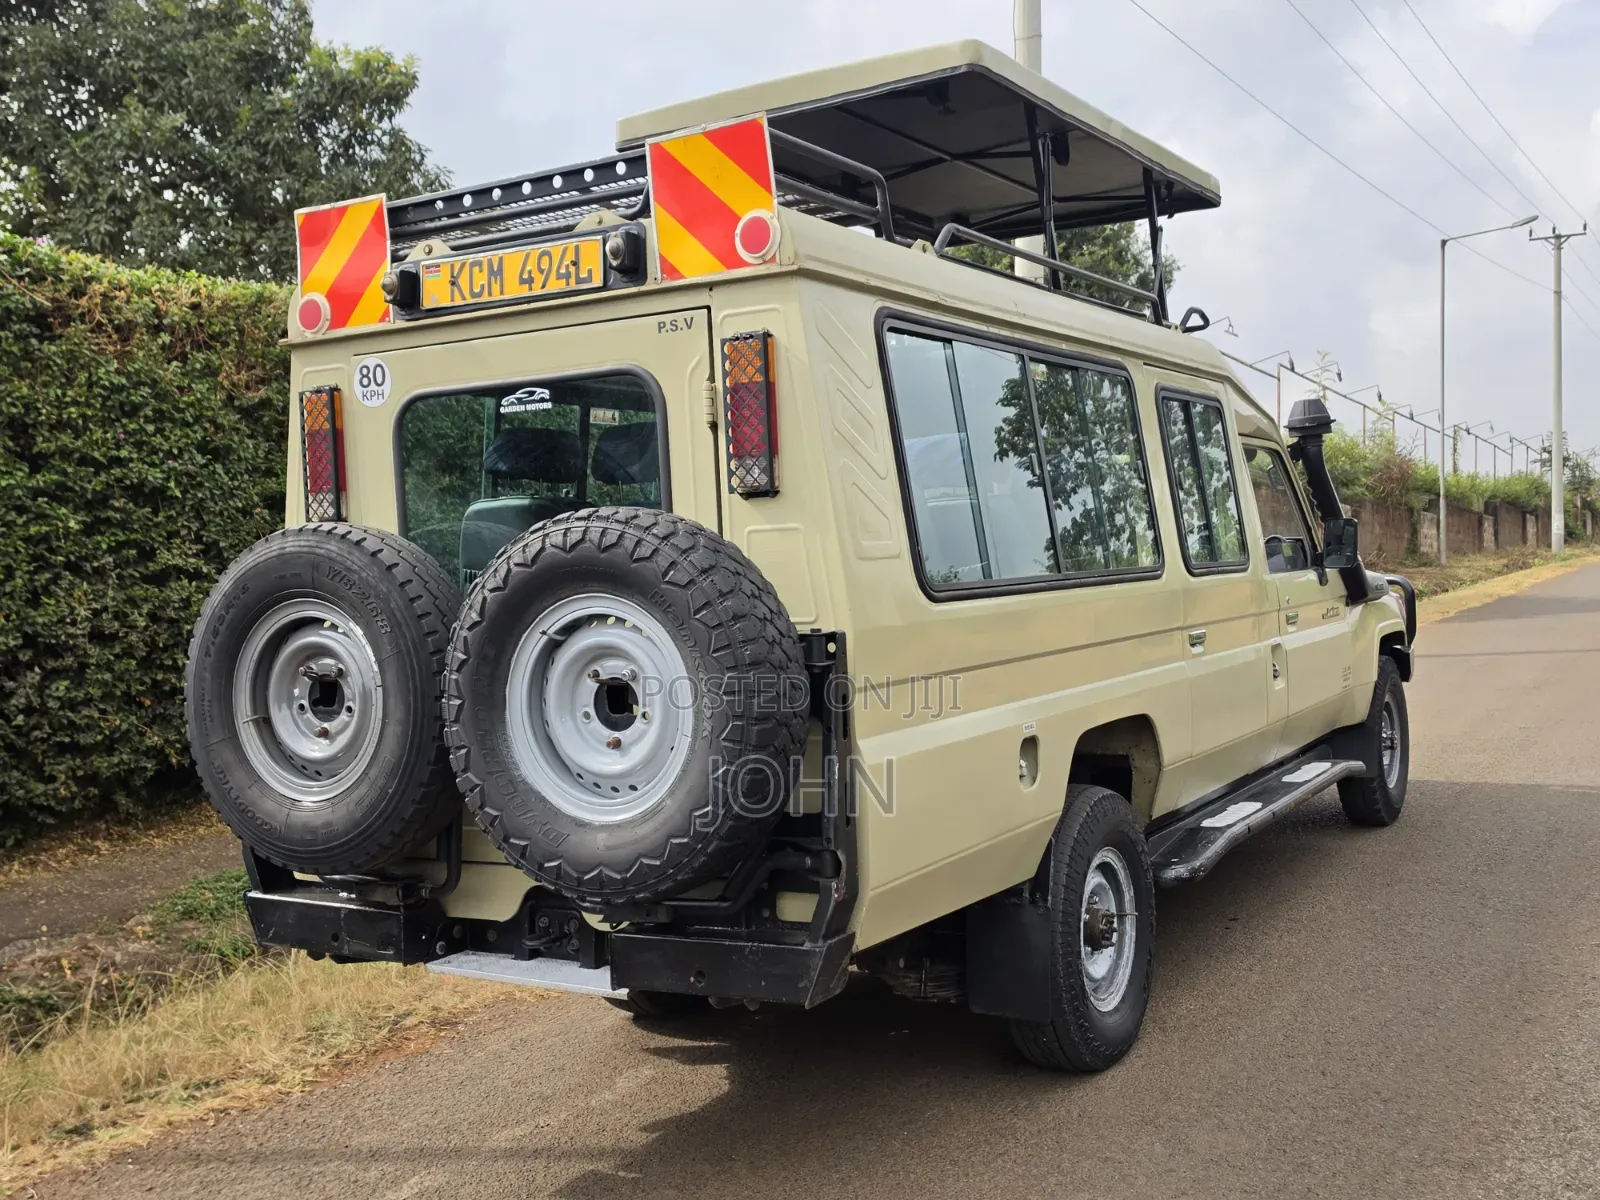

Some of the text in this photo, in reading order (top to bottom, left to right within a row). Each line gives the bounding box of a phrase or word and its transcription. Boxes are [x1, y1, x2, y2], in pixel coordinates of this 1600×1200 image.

[449, 243, 593, 303] KCM 494L
[657, 316, 694, 334] P.S.V
[358, 363, 386, 389] 80
[361, 389, 385, 401] KPH
[500, 402, 552, 414] GARDEN MOTORS
